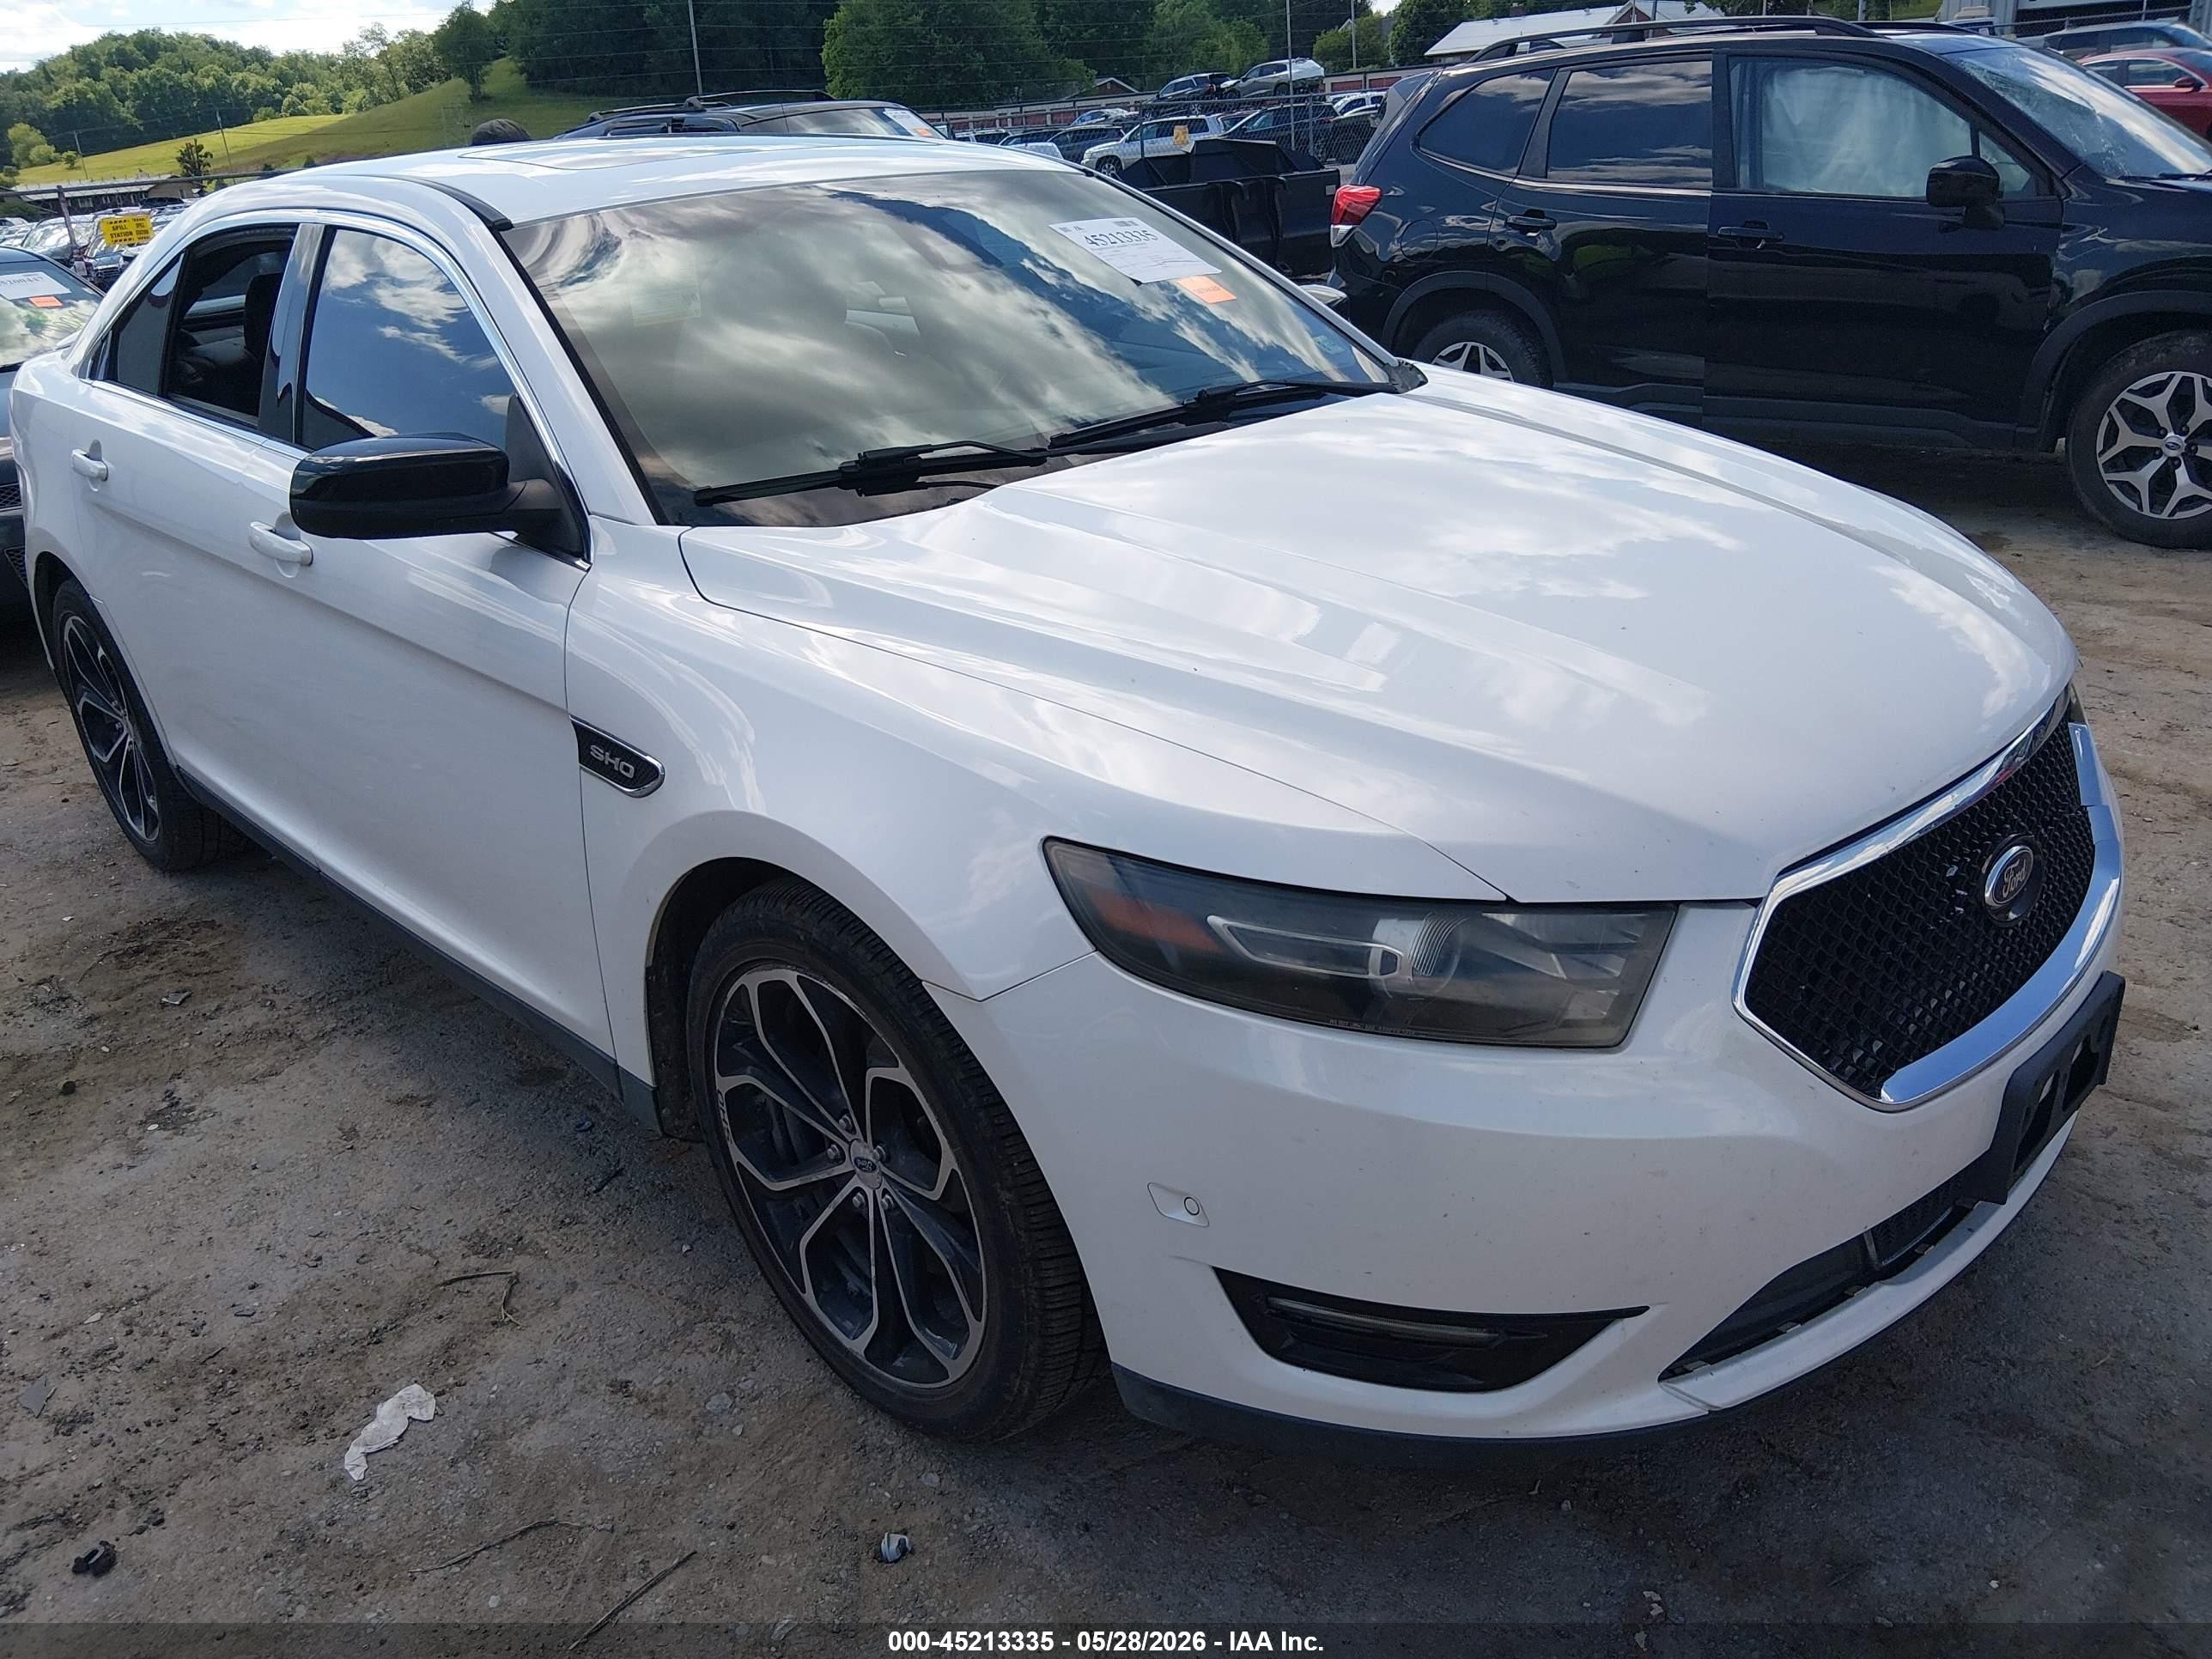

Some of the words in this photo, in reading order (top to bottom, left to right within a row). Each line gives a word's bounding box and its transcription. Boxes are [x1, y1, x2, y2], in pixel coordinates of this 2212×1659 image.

[110, 230, 133, 239] STATION
[1085, 230, 1158, 246] 45213335
[590, 744, 635, 779] SHO
[2002, 858, 2027, 898] Ford
